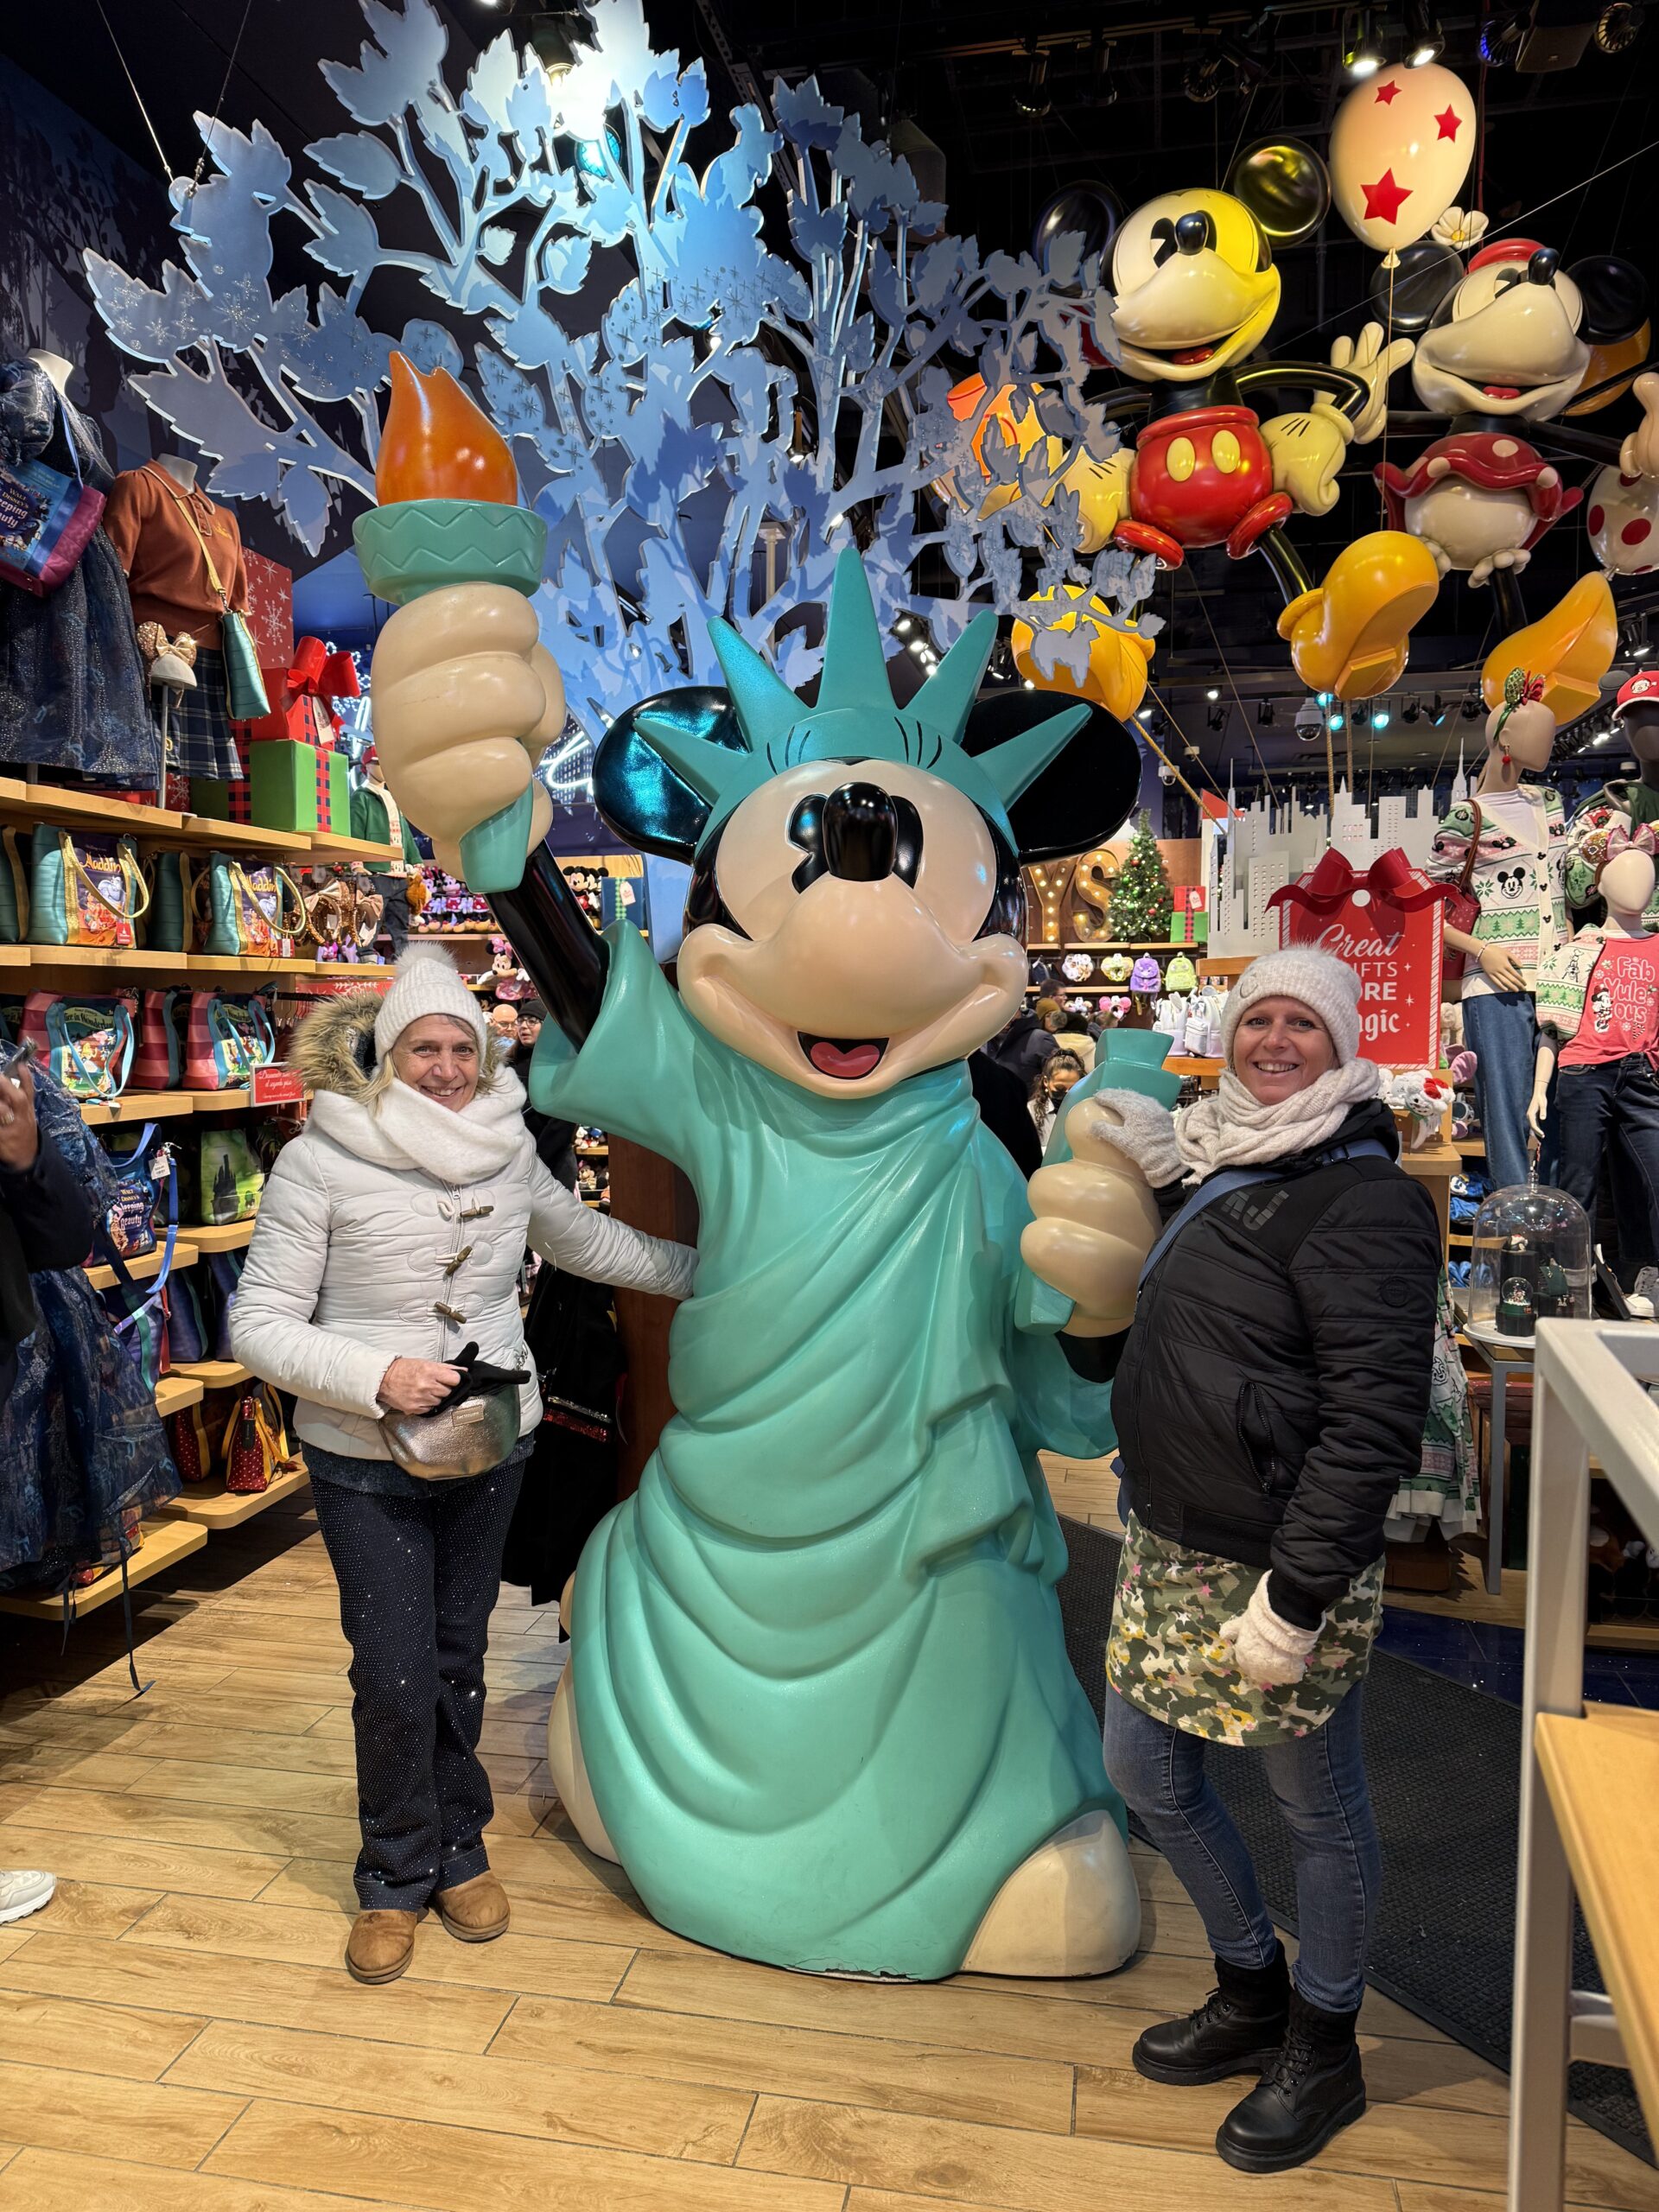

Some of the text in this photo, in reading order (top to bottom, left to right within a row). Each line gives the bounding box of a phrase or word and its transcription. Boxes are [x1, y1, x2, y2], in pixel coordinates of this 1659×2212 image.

[0, 499, 29, 519] eping
[80, 851, 121, 874] Aladdin
[1313, 924, 1406, 957] Great
[1353, 961, 1398, 977] IFTS
[1618, 956, 1656, 982] Fab
[1361, 982, 1397, 1001] RE
[1604, 977, 1647, 1004] Yule
[120, 1202, 144, 1214] leeping
